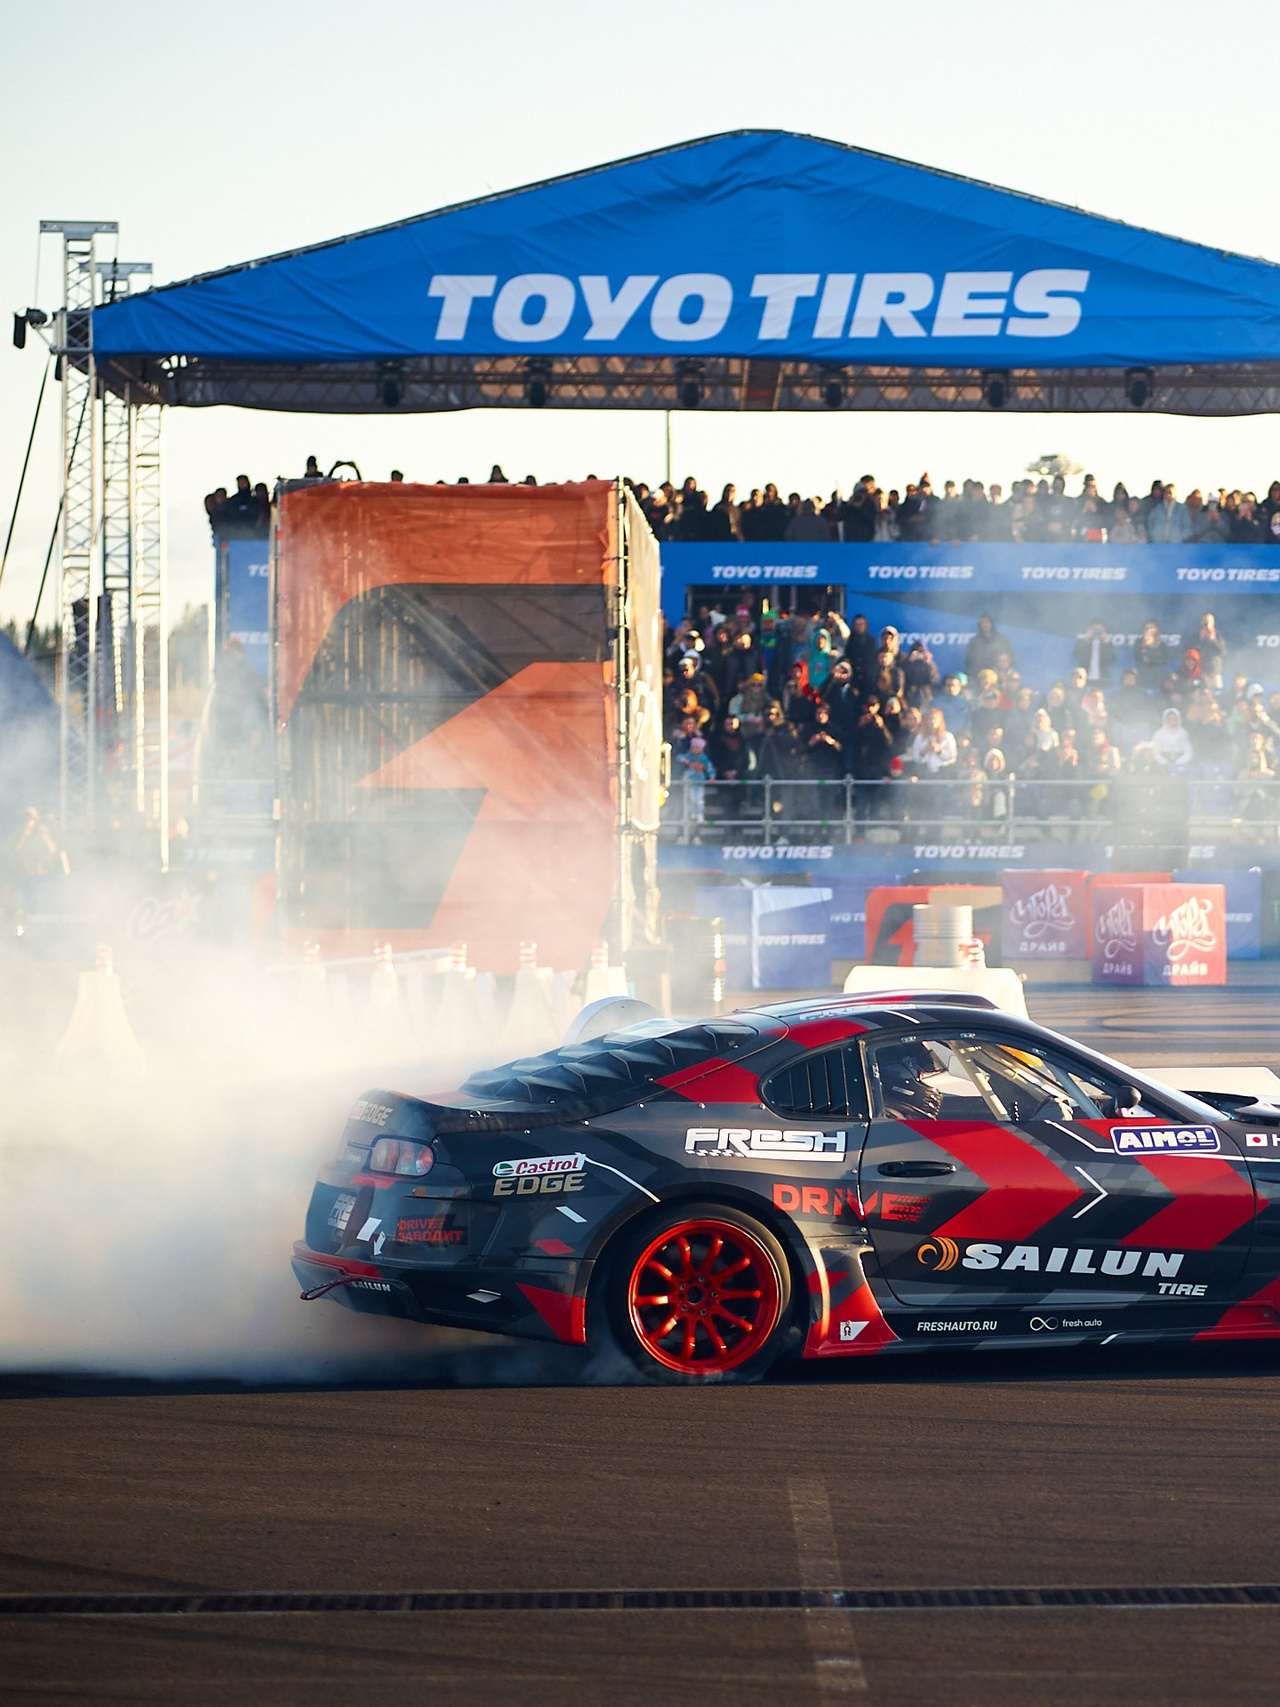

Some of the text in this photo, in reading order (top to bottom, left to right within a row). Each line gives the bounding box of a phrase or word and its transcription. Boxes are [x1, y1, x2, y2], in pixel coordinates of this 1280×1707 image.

[427, 269, 1091, 342] TOYO TIRES
[711, 565, 819, 579] TOYO TIRES
[867, 565, 975, 579] TOYO TIRES
[1021, 566, 1127, 581] TOYO TIRES
[1176, 568, 1226, 582] TOYO
[721, 845, 834, 860] TOYO TIRES
[913, 845, 1025, 859] TOYO TIRES
[757, 934, 790, 947] TOYO
[790, 933, 826, 946] TIRES
[1162, 960, 1208, 976] ДРАЙВ
[361, 1104, 393, 1126] EDGE
[1119, 1131, 1215, 1148] AIMOL
[514, 1156, 580, 1176] Castrol
[493, 1172, 587, 1196] EDGE
[962, 1243, 1184, 1278] SAILUN
[1158, 1282, 1209, 1297] TIRE
[917, 1320, 997, 1331] FRESHAUTO.RU
[1062, 1317, 1102, 1328] fresh auto
